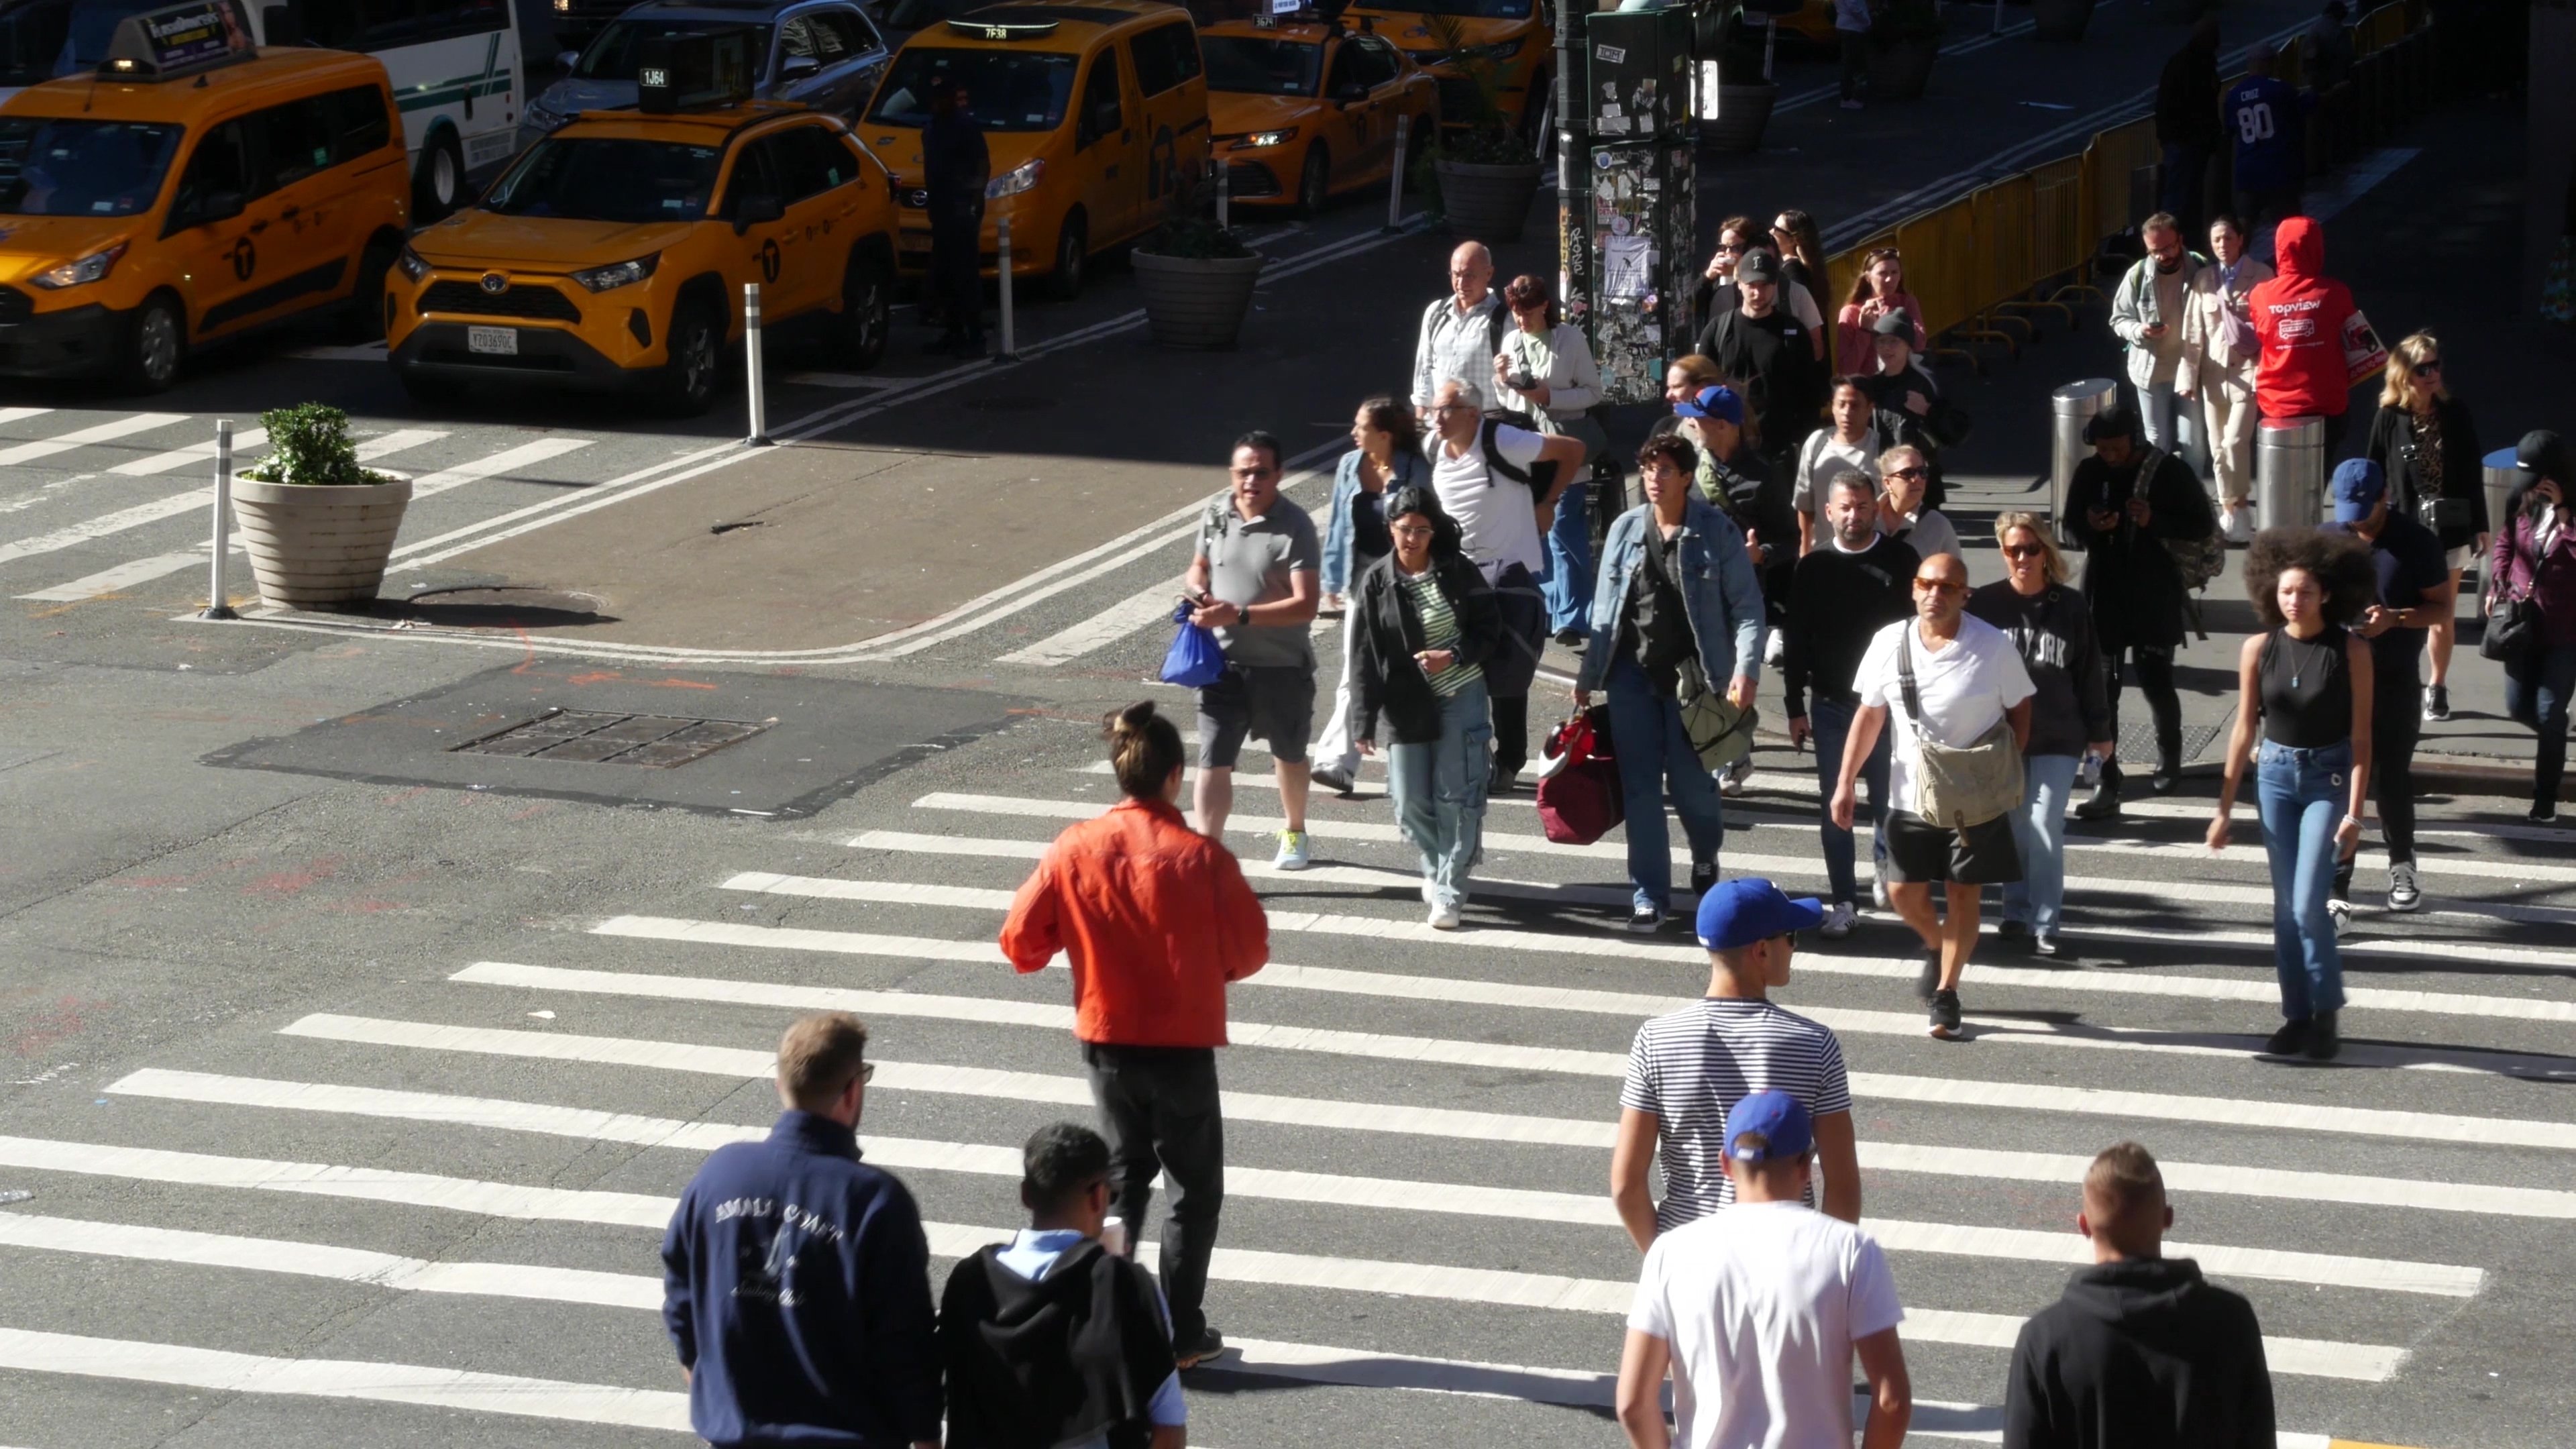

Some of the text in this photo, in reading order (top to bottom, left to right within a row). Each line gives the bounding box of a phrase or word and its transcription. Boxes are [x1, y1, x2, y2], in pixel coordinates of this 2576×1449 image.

[985, 28, 1007, 39] 7F38
[645, 70, 664, 85] 1J64
[2237, 103, 2275, 144] 80
